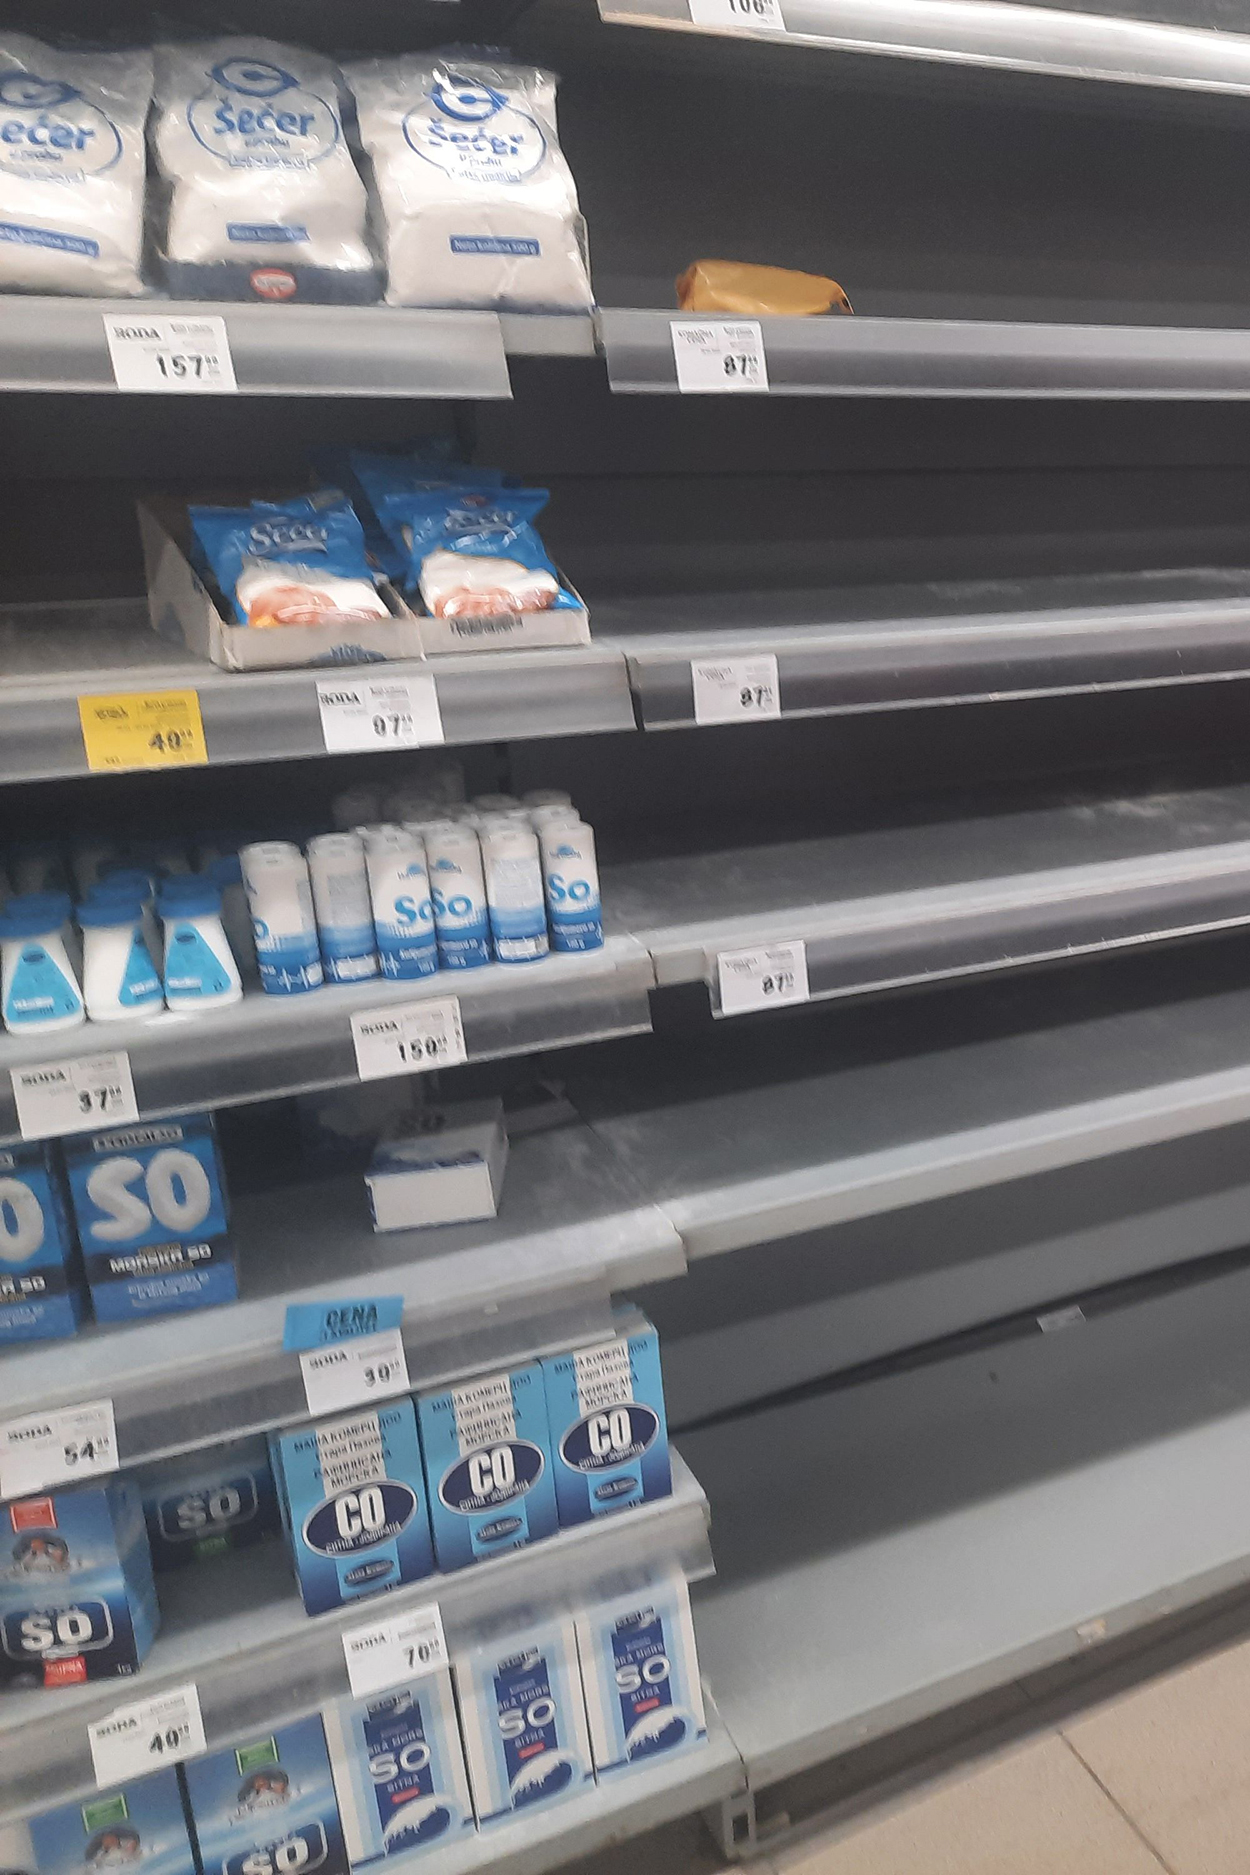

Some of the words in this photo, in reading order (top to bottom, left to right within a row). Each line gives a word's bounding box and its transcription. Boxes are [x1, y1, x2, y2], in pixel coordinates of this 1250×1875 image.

[0, 111, 95, 150] ećer
[547, 873, 590, 901] So
[86, 1148, 211, 1241] SO
[178, 1489, 241, 1529] SO
[21, 1613, 93, 1651] SO
[615, 1654, 671, 1693] SO
[498, 1696, 556, 1740] SO
[368, 1741, 431, 1784] SO
[242, 1836, 309, 1875] SO
